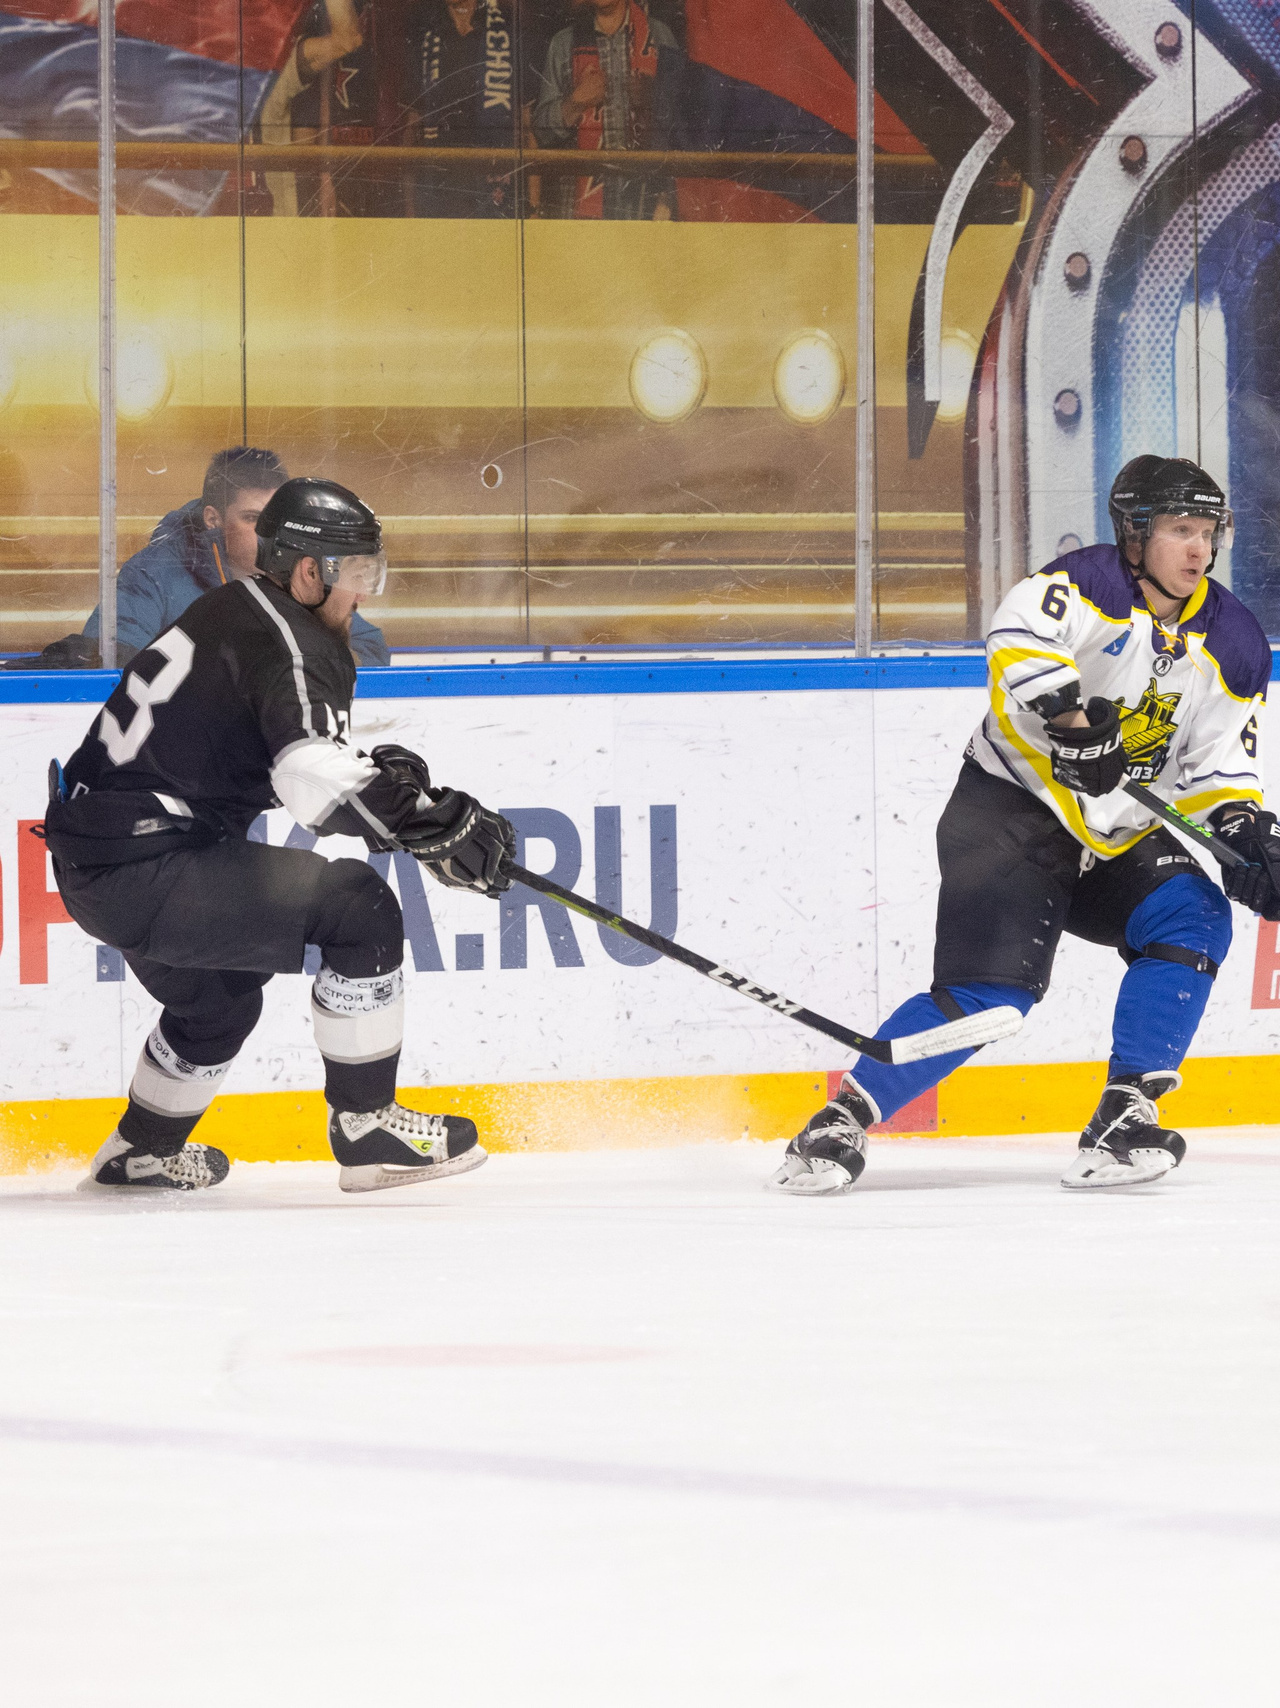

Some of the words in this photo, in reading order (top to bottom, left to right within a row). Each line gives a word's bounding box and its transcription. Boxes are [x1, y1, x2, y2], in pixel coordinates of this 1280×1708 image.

[1193, 494, 1221, 503] BAUER
[284, 521, 322, 534] BAUER
[1041, 583, 1071, 622] 6
[1240, 713, 1258, 758] 6
[1220, 817, 1245, 832] BAUER
[708, 965, 804, 1017] CCM
